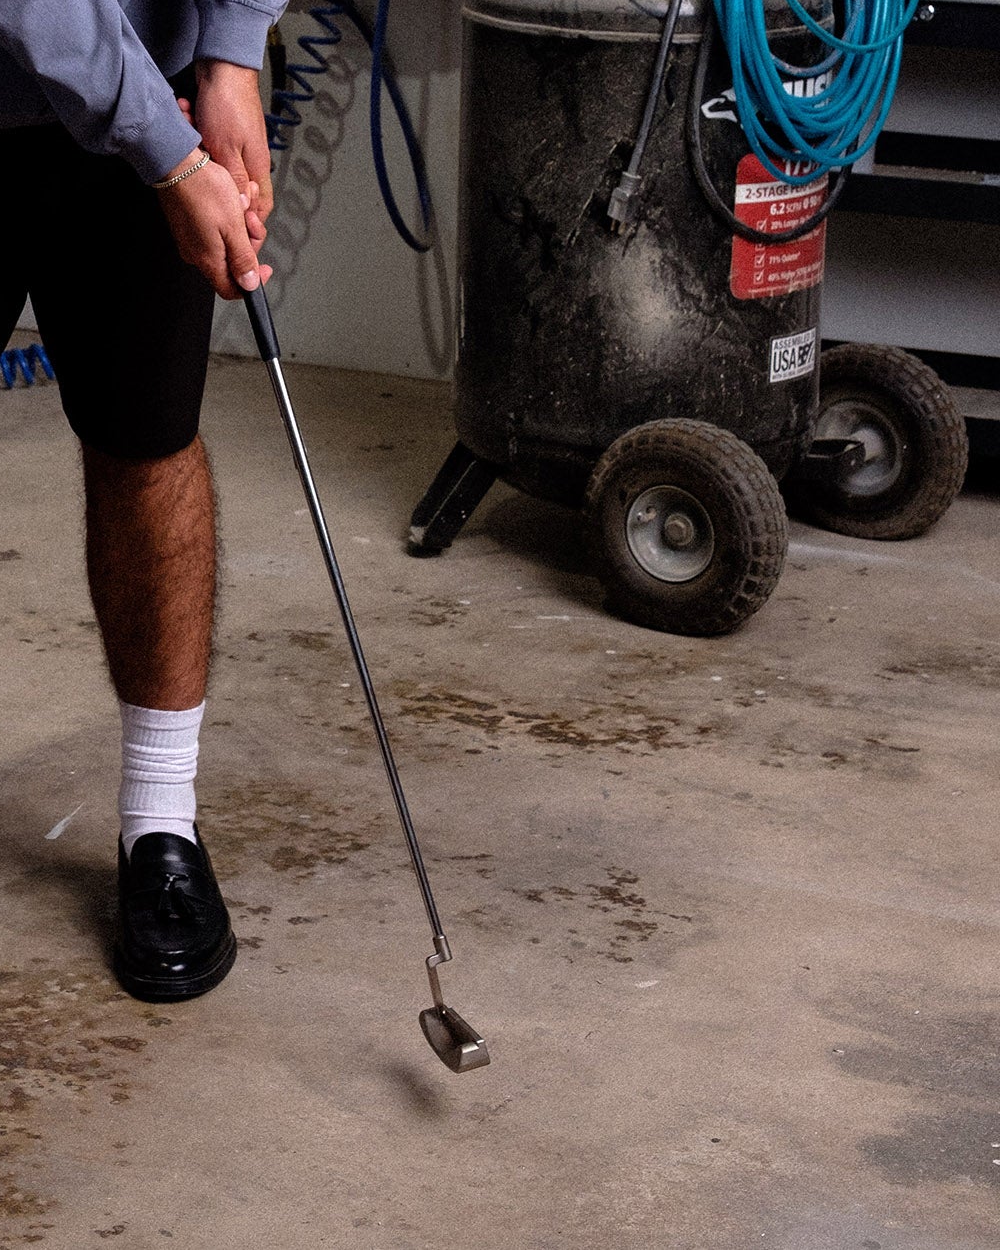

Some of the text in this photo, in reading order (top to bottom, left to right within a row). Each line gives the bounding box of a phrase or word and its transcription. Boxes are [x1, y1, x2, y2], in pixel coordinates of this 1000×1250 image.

[745, 185, 788, 199] 2-STAGE
[770, 202, 786, 216] 6.2
[773, 348, 796, 373] USA
